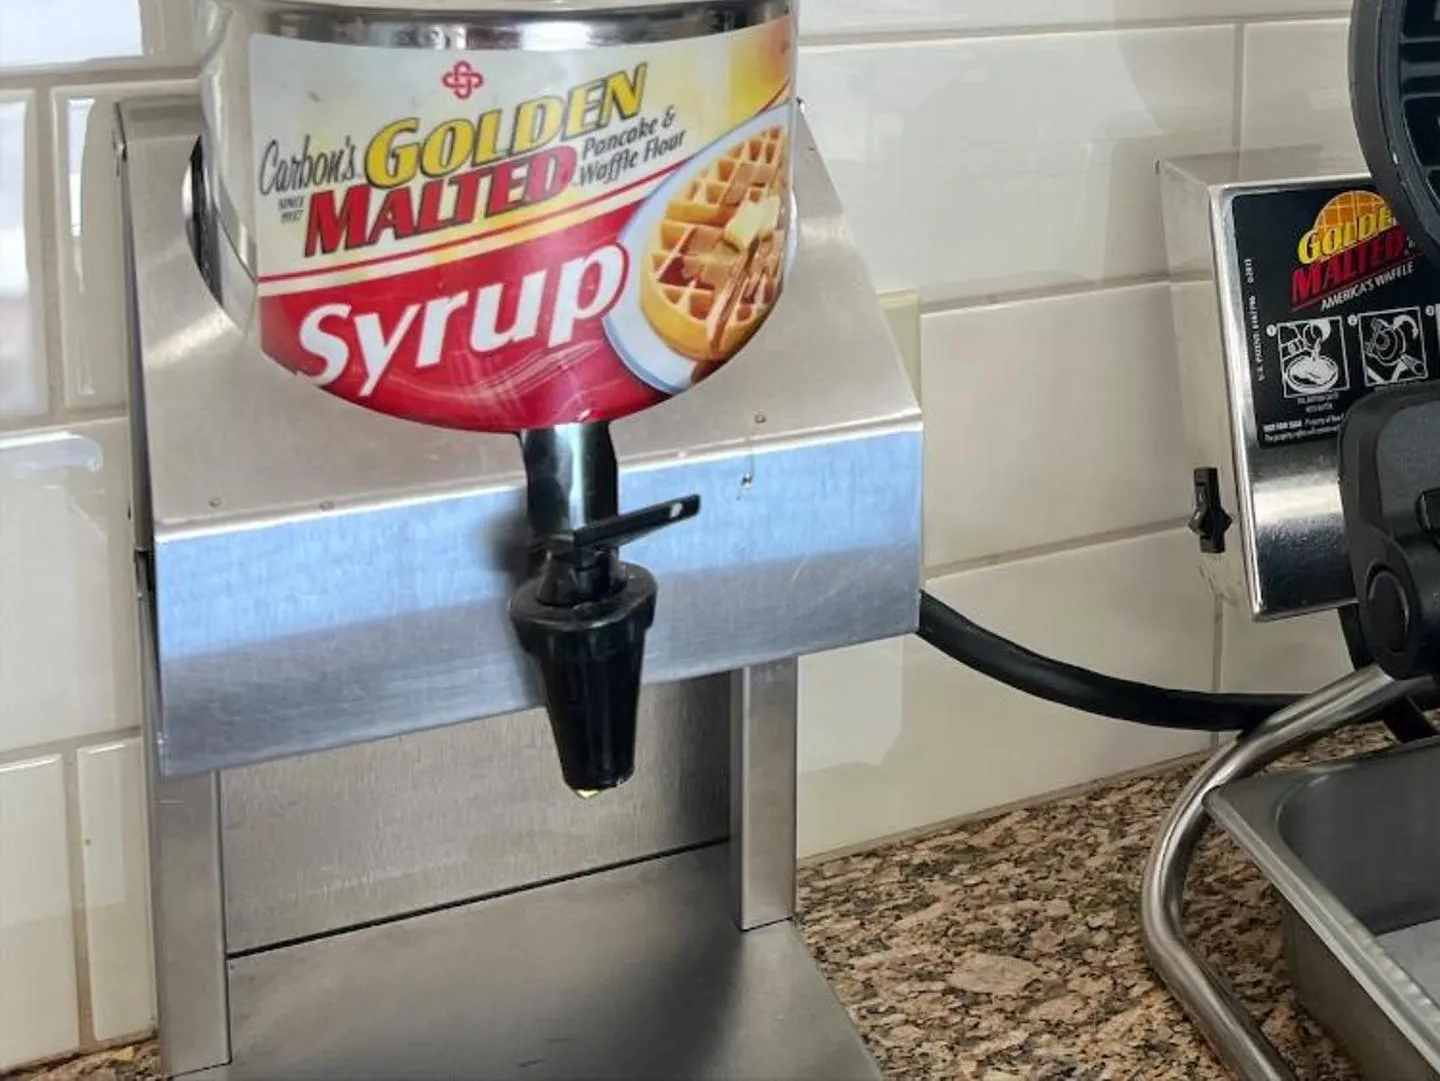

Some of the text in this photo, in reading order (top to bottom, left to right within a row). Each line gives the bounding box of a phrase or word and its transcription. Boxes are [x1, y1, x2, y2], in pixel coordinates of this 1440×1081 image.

[259, 61, 648, 196] Carbon's GOLDEN
[578, 129, 688, 187] Waffle Flour
[582, 104, 676, 161] Pancake &
[303, 145, 577, 258] MALTED
[1297, 203, 1398, 265] GOLDE
[1290, 223, 1409, 306] MALTED
[299, 241, 628, 397] Syrup
